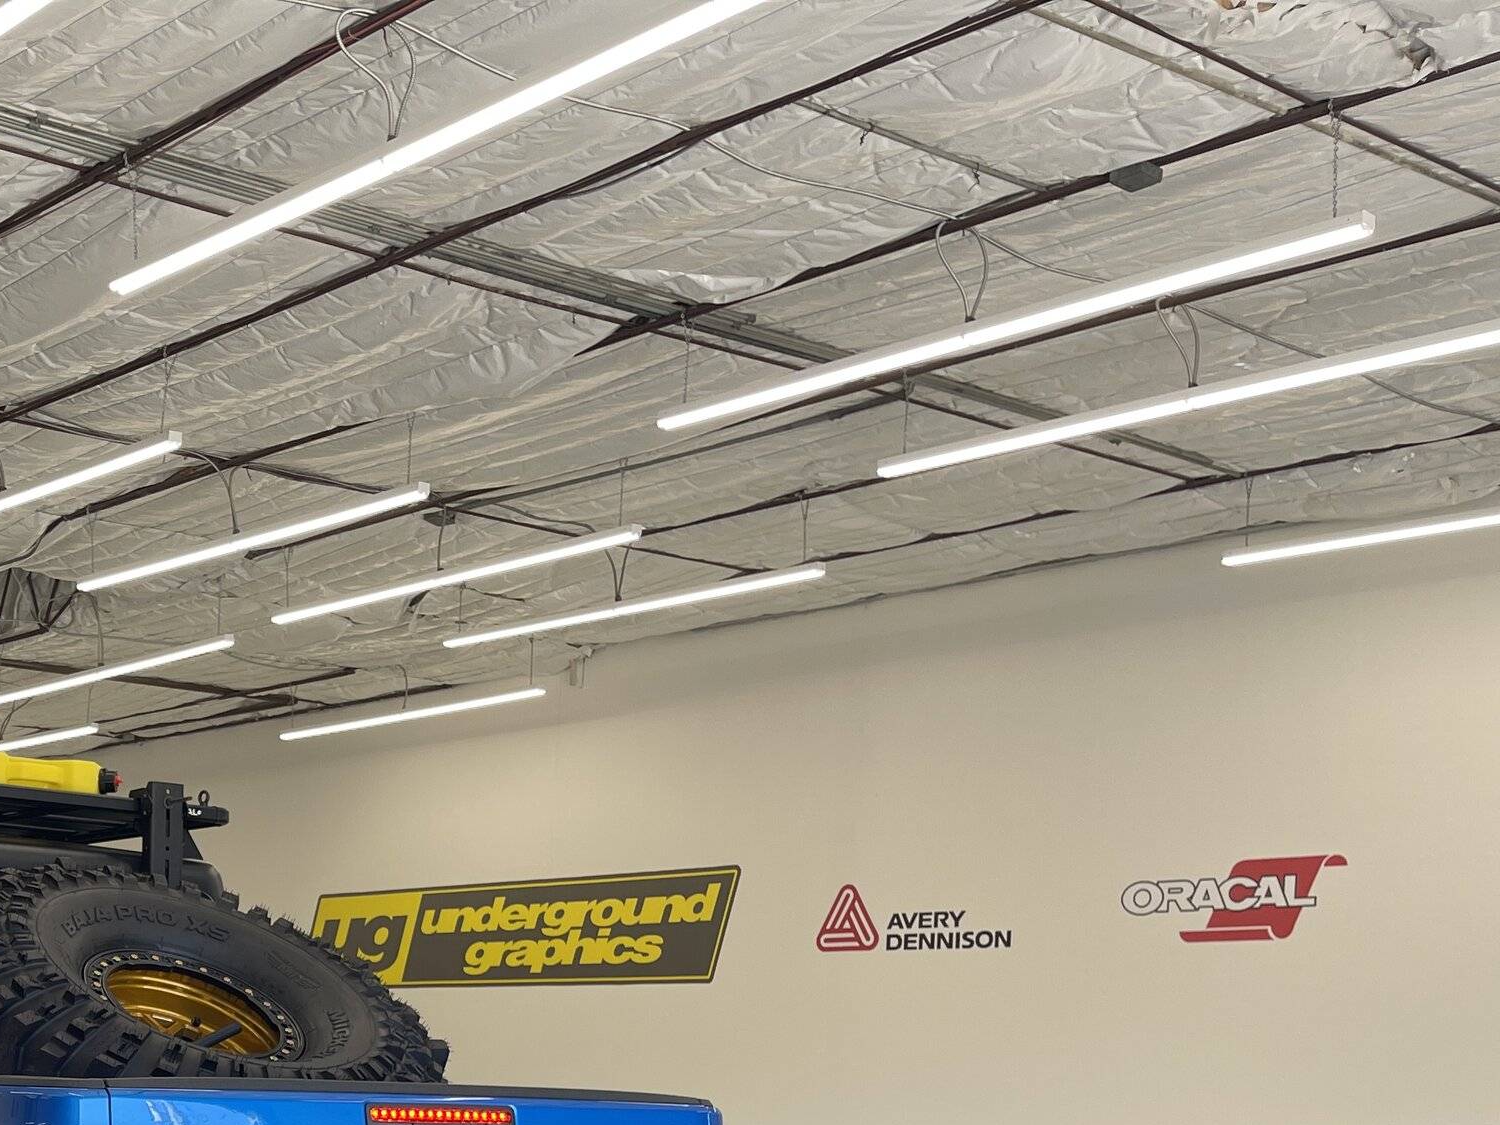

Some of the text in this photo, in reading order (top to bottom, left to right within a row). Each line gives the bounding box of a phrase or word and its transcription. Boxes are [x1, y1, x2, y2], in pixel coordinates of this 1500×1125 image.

[420, 882, 722, 938] underground
[1120, 874, 1316, 916] ORACAL
[114, 905, 177, 928] PRO
[886, 910, 967, 930] AVERY
[462, 928, 663, 976] graphics
[885, 930, 1013, 952] DENNISON
